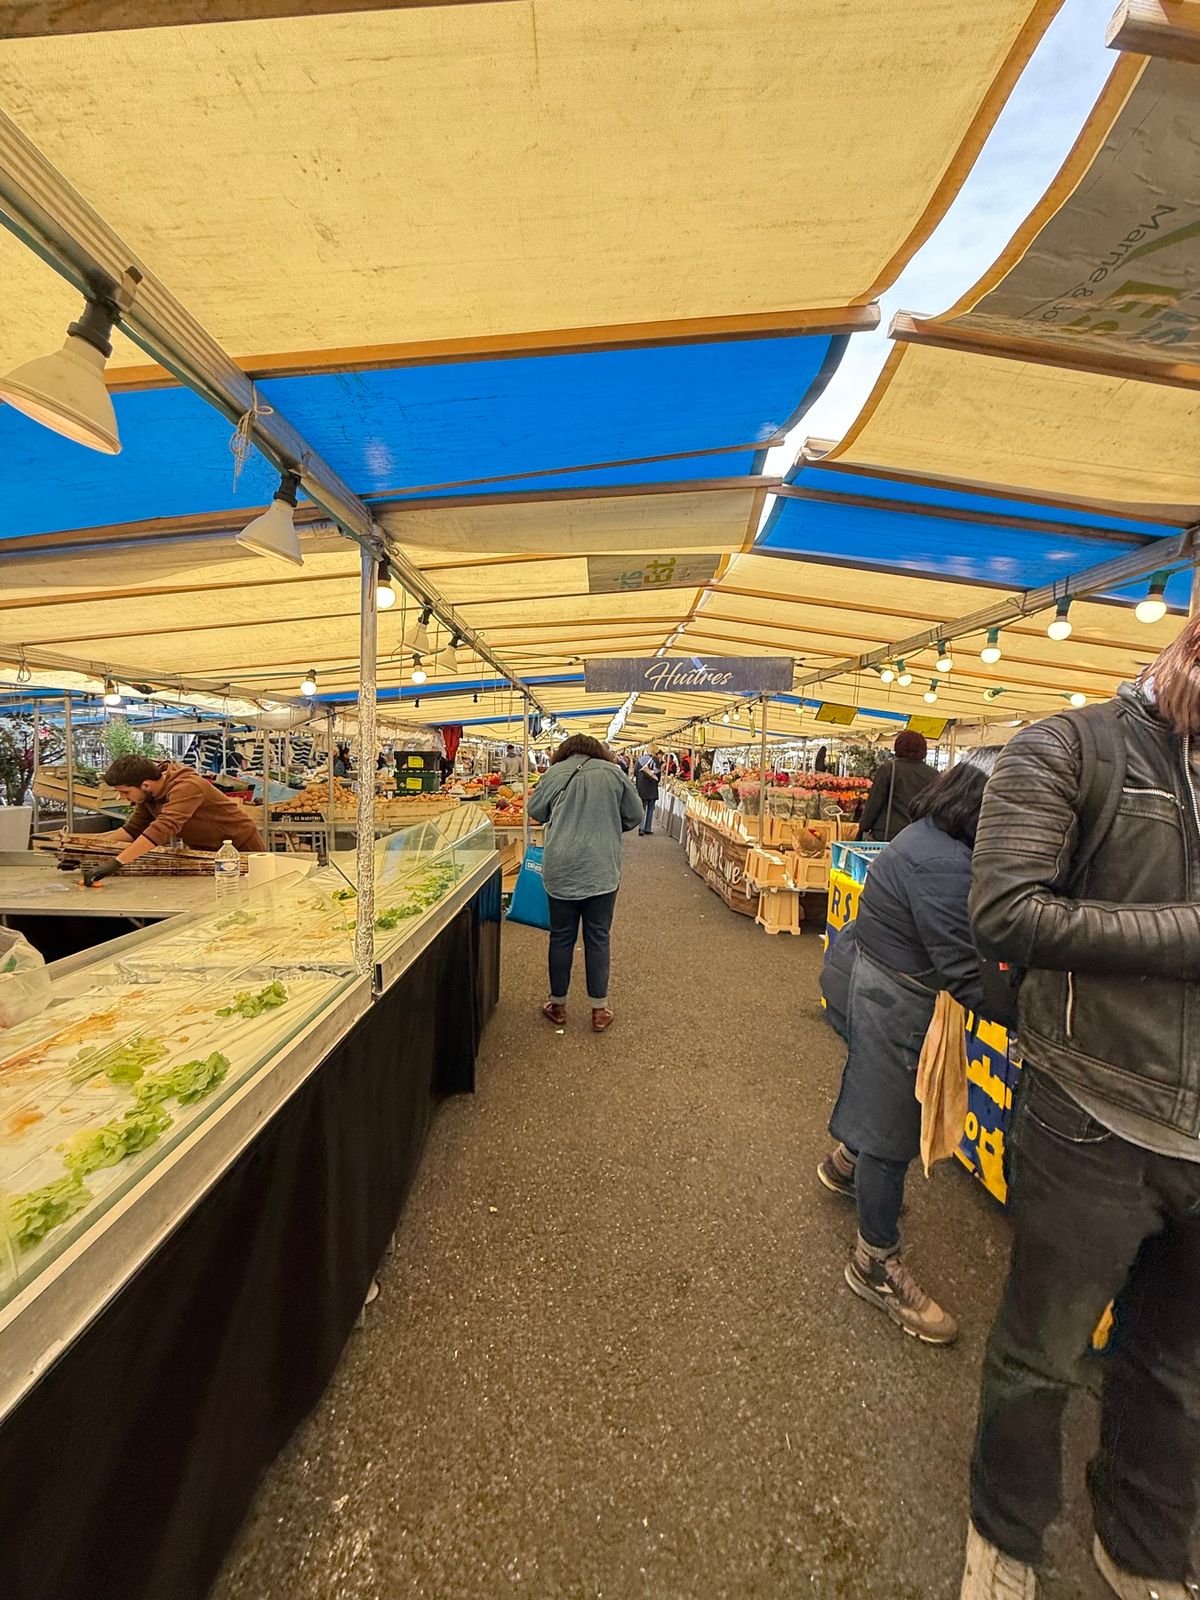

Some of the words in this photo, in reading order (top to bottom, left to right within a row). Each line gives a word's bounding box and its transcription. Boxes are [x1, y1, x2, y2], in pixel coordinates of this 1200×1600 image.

[1089, 204, 1177, 284] Marne
[1072, 287, 1094, 298] &
[643, 556, 677, 583] Est
[644, 661, 734, 691] Huîtres
